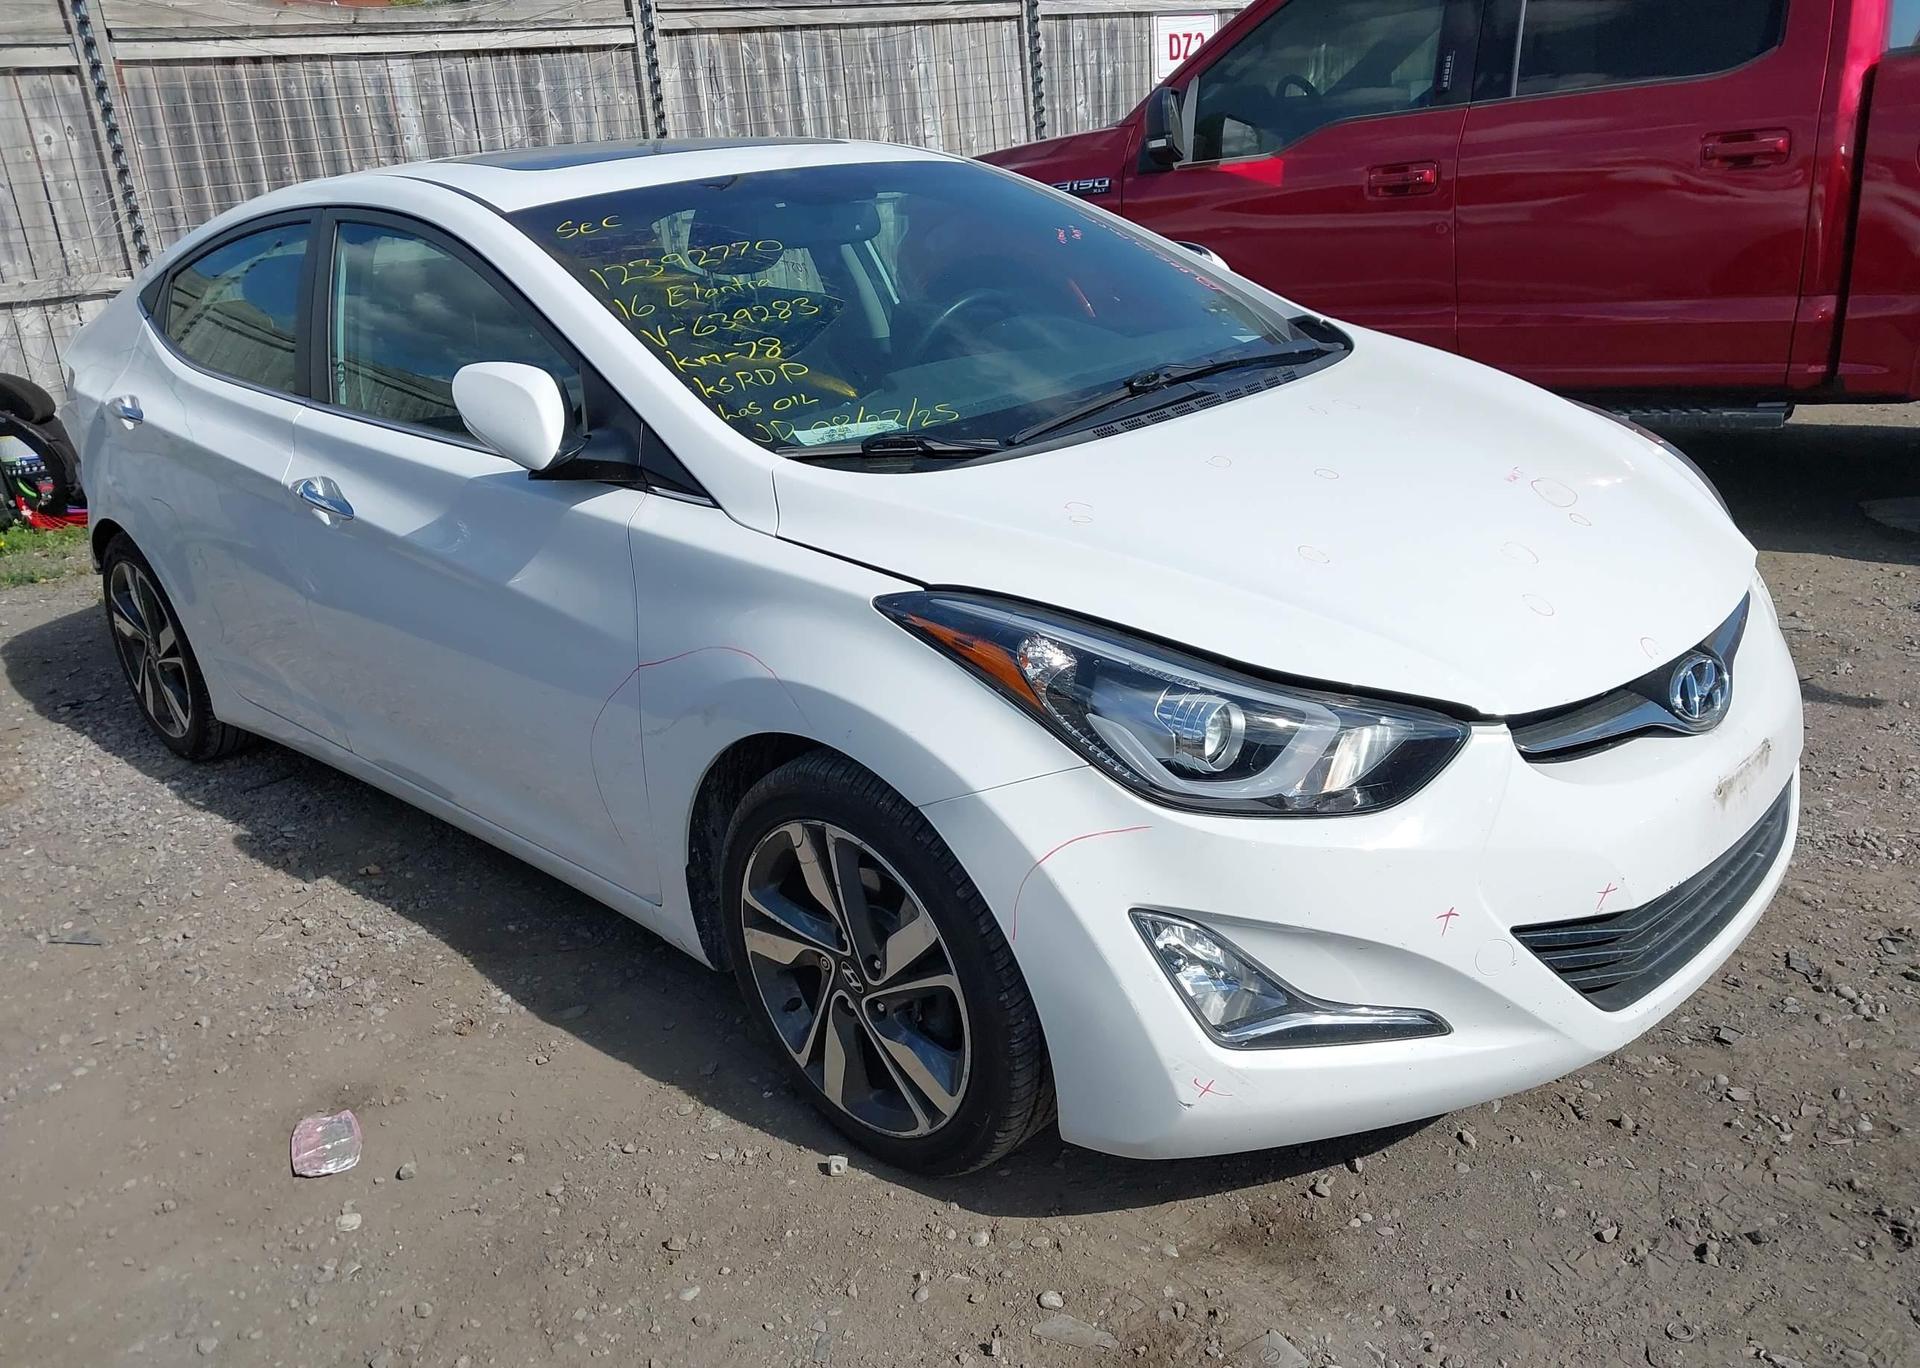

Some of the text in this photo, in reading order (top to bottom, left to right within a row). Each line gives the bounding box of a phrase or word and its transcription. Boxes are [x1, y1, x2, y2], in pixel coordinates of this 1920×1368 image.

[589, 240, 783, 290] 12392770
[614, 275, 774, 321] 16 Elantra
